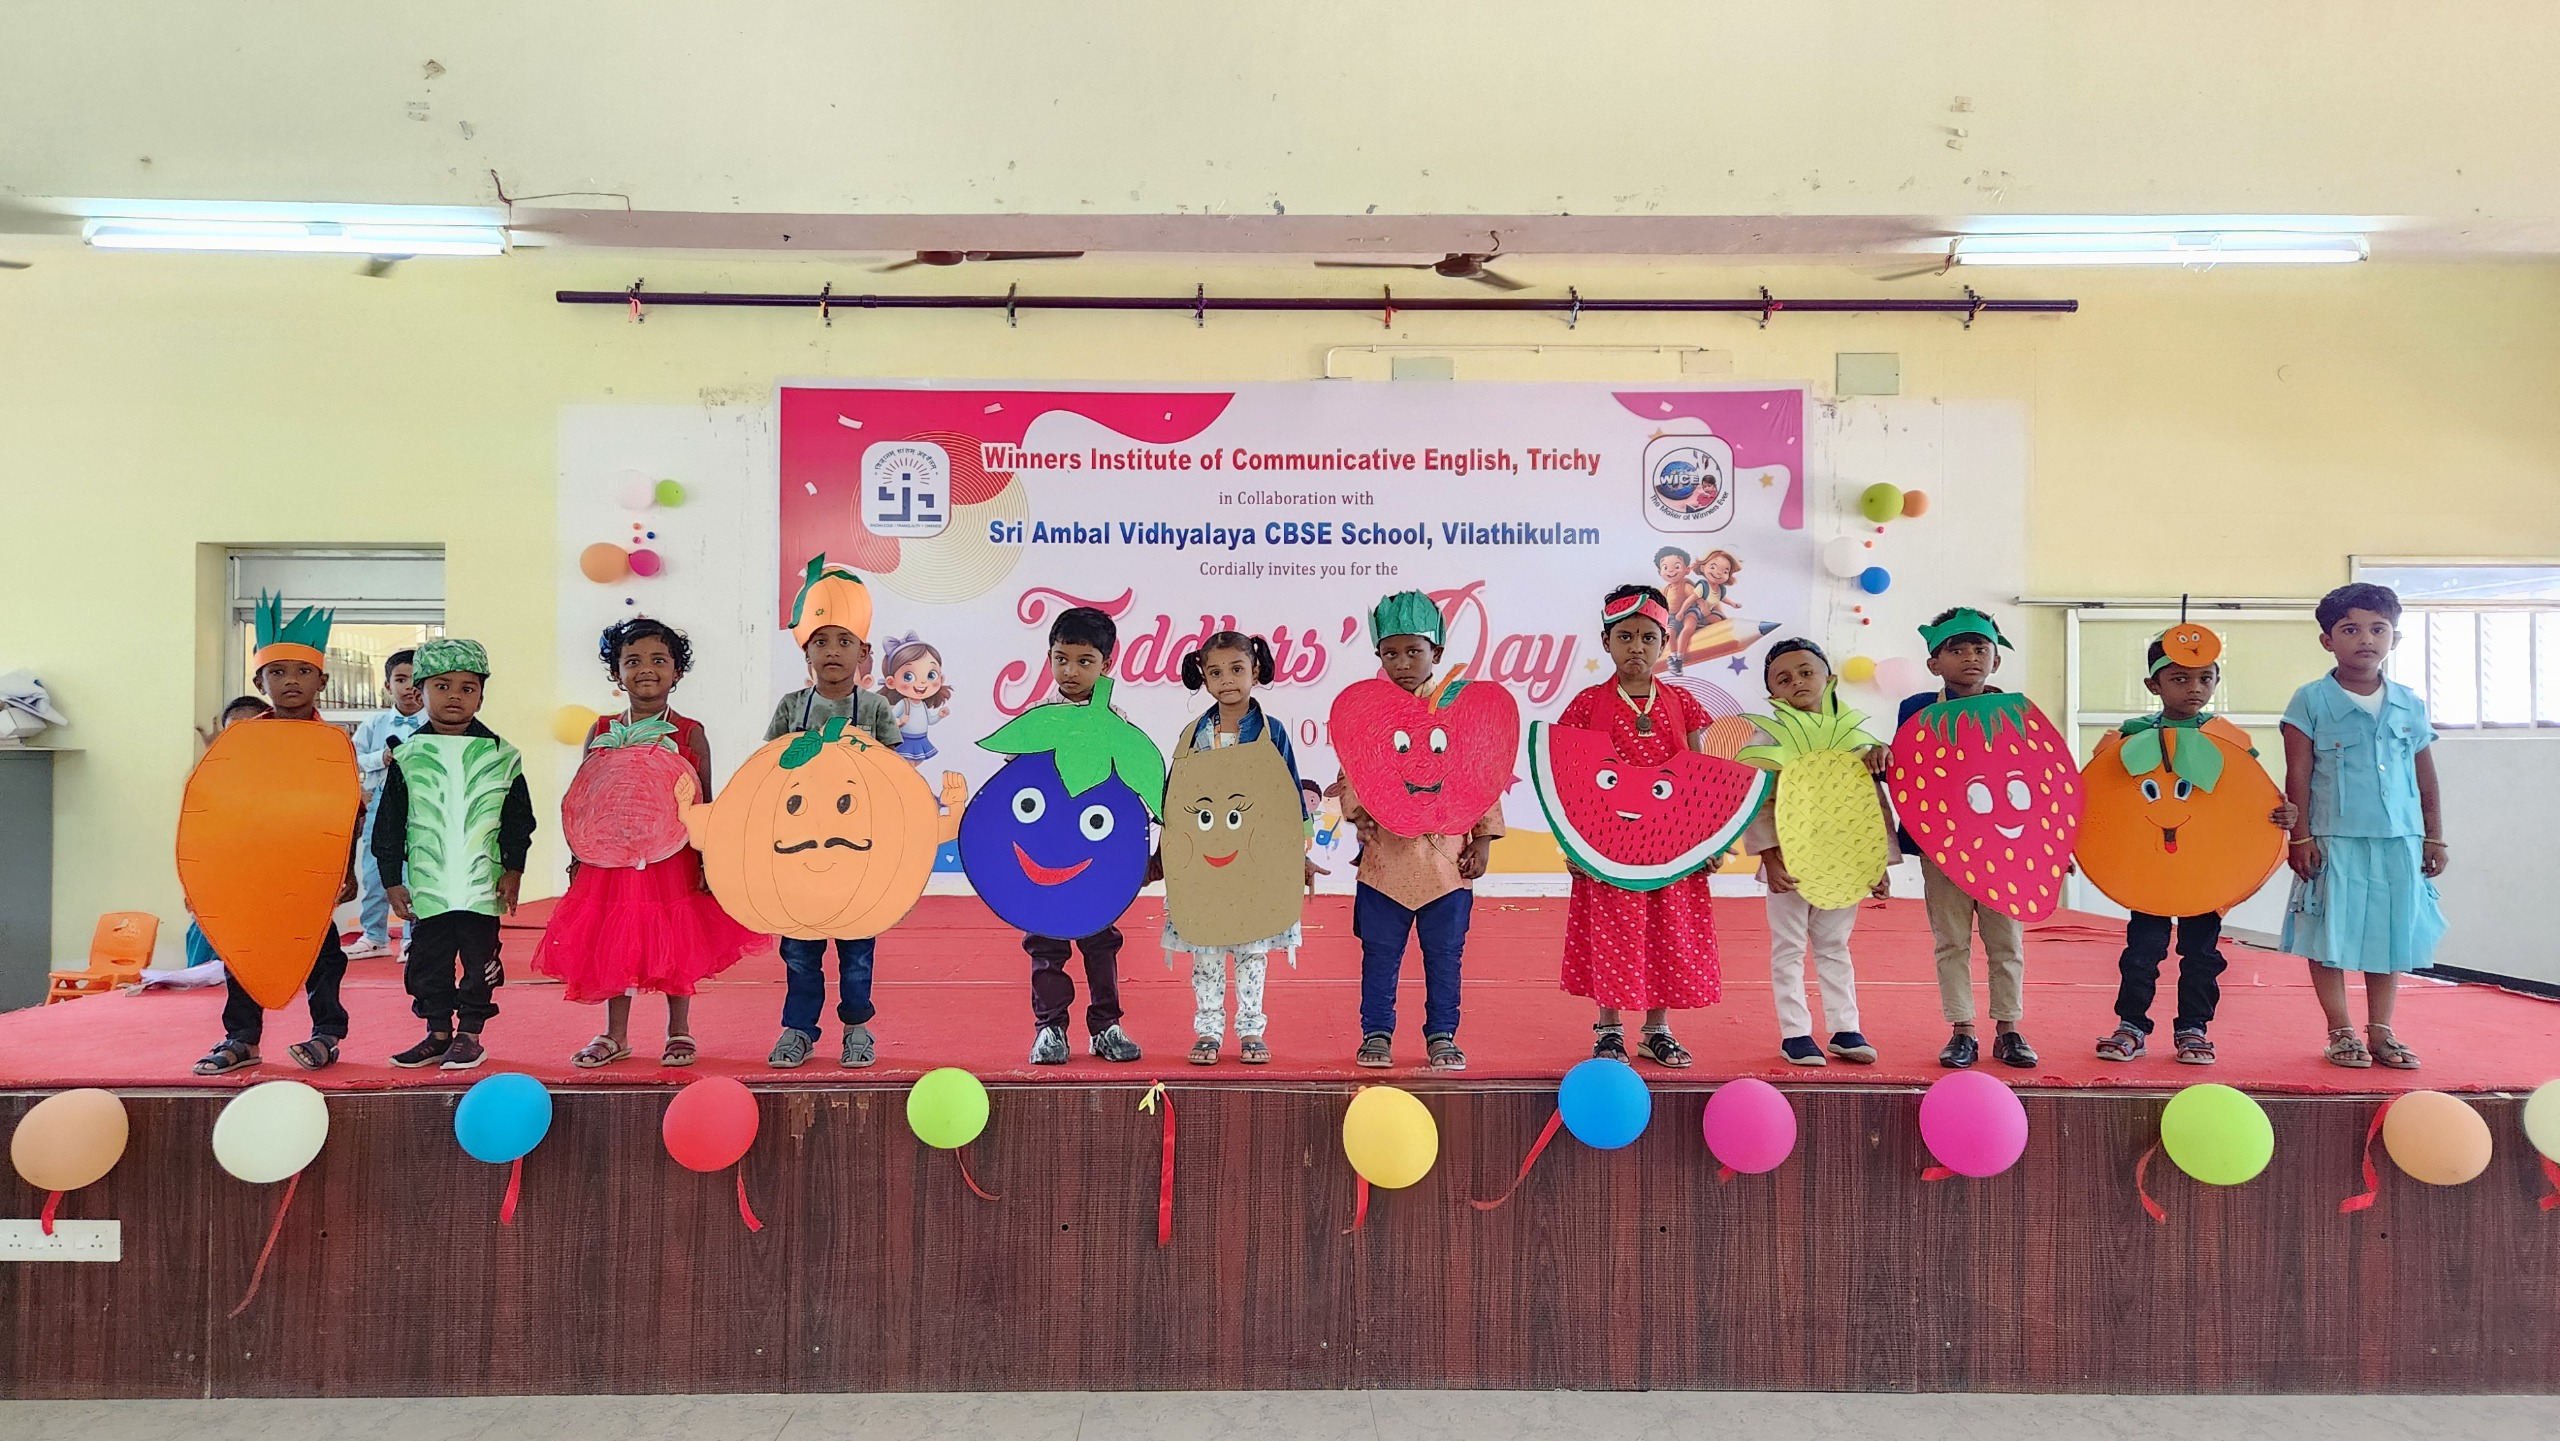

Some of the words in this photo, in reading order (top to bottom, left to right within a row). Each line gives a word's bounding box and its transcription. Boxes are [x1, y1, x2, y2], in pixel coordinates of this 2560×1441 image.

[984, 446, 1082, 470] Winners
[1091, 447, 1192, 471] Institute
[1199, 448, 1223, 471] of
[1232, 447, 1416, 471] Communicative
[1424, 447, 1518, 477] English,
[1526, 447, 1601, 476] Trichy
[1219, 491, 1233, 505] in
[1237, 490, 1337, 505] Collaboration
[1341, 490, 1374, 505] with
[1649, 494, 1661, 507] The
[1659, 505, 1682, 520] Maker
[1682, 513, 1691, 521] of
[1691, 505, 1720, 521] Winners
[1716, 491, 1729, 506] Ever
[988, 520, 1023, 544] Sri
[1032, 521, 1110, 544] Ambal
[1119, 521, 1256, 550] Vidhyalaya
[1265, 521, 1332, 545] CBSE
[1341, 522, 1433, 550] School,
[1442, 521, 1600, 545] Vilathikulam
[1200, 561, 1265, 579] Cordially
[1268, 562, 1316, 576] invites
[1320, 565, 1346, 580] you
[1350, 562, 1372, 576] for
[1375, 562, 1398, 576] the
